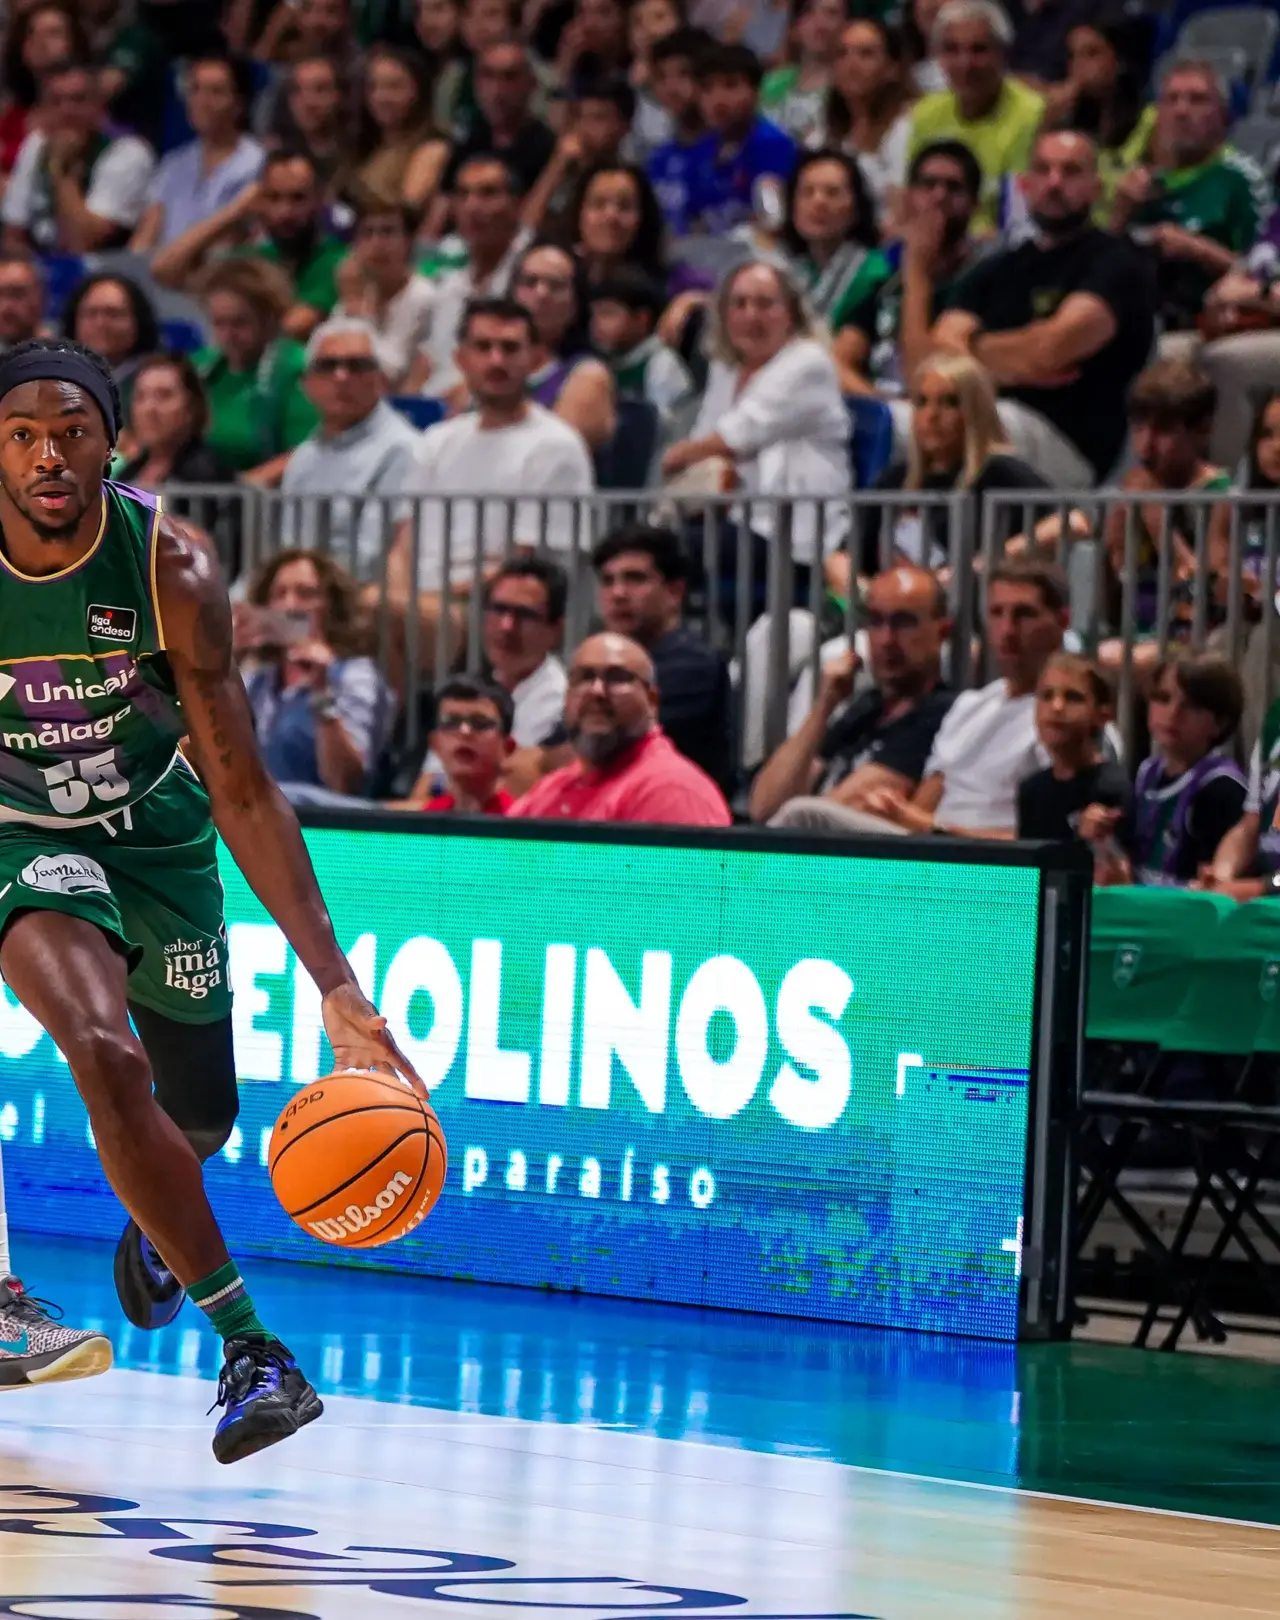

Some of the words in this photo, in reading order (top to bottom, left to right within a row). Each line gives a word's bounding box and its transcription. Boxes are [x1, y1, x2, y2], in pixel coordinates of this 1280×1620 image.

[91, 614, 111, 626] liga
[91, 625, 131, 637] endesa
[38, 748, 130, 814] 55
[163, 938, 203, 955] sabor
[308, 1170, 413, 1240] Wilson
